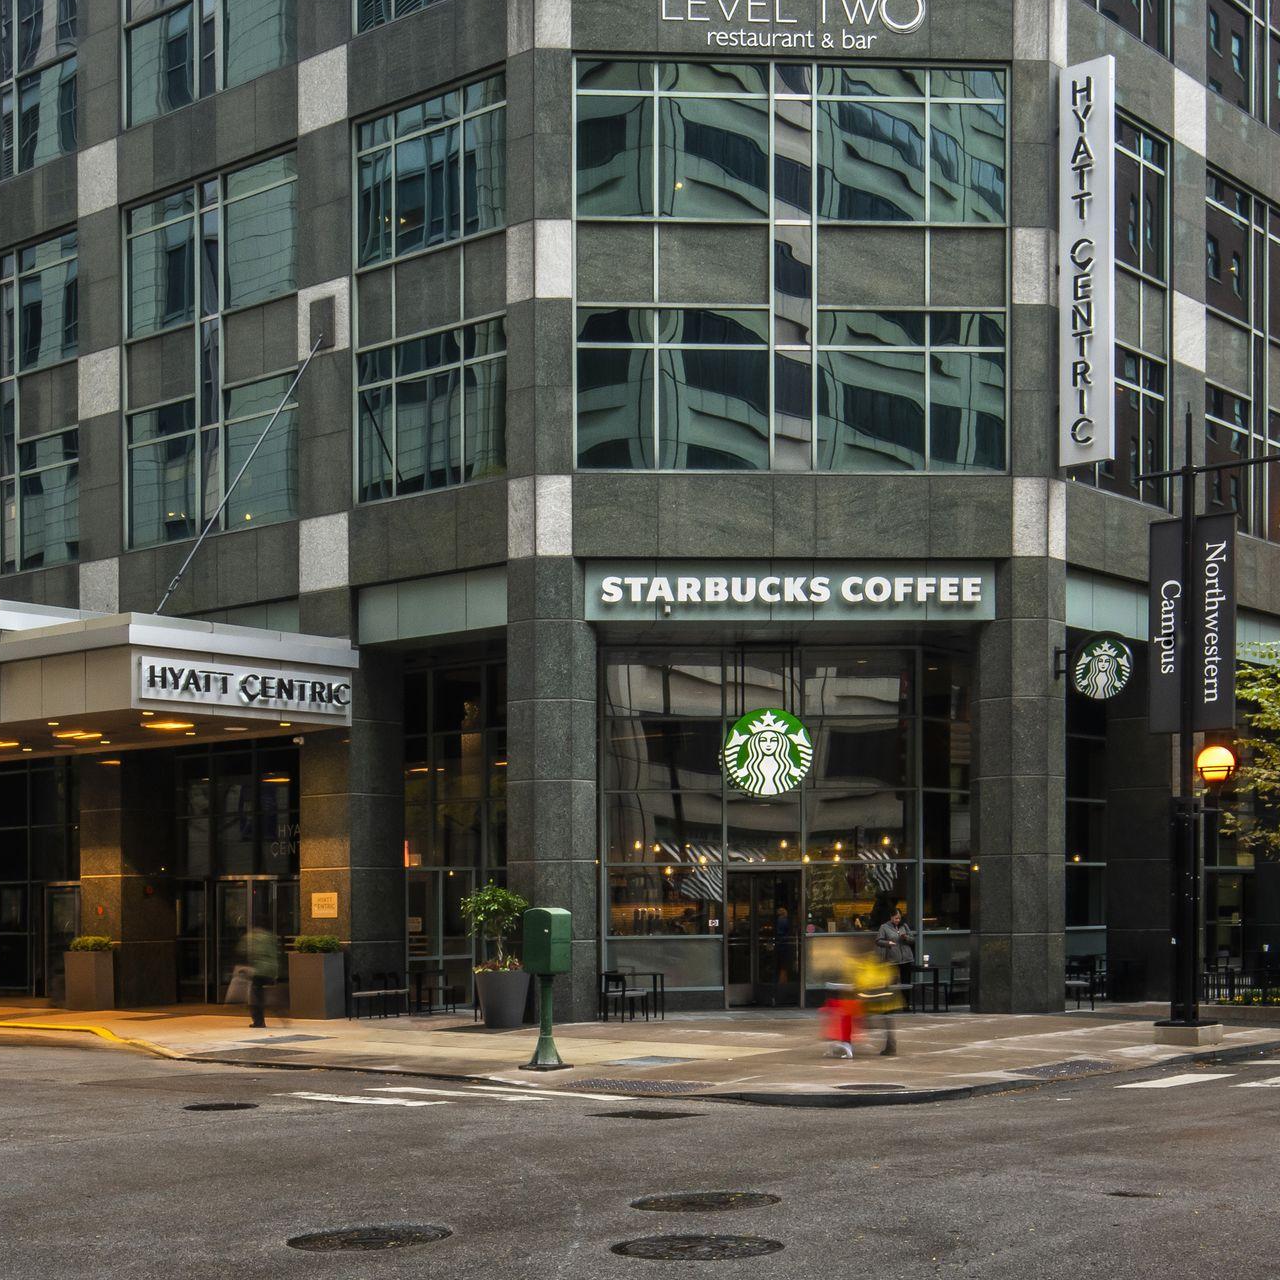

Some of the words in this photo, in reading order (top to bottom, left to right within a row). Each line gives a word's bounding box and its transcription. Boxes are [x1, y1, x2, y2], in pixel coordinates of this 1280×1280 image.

[707, 28, 815, 49] restaurant
[821, 33, 834, 49] &
[841, 30, 877, 50] bar
[1071, 76, 1094, 221] HYATT
[1070, 238, 1094, 445] CENTRIC
[600, 575, 831, 602] STARBUCKS
[840, 576, 982, 602] COFFEE
[1154, 579, 1181, 674] Campus
[1204, 540, 1227, 704] Northwestern
[148, 665, 233, 694] HYATT
[239, 674, 351, 705] CENTRIC
